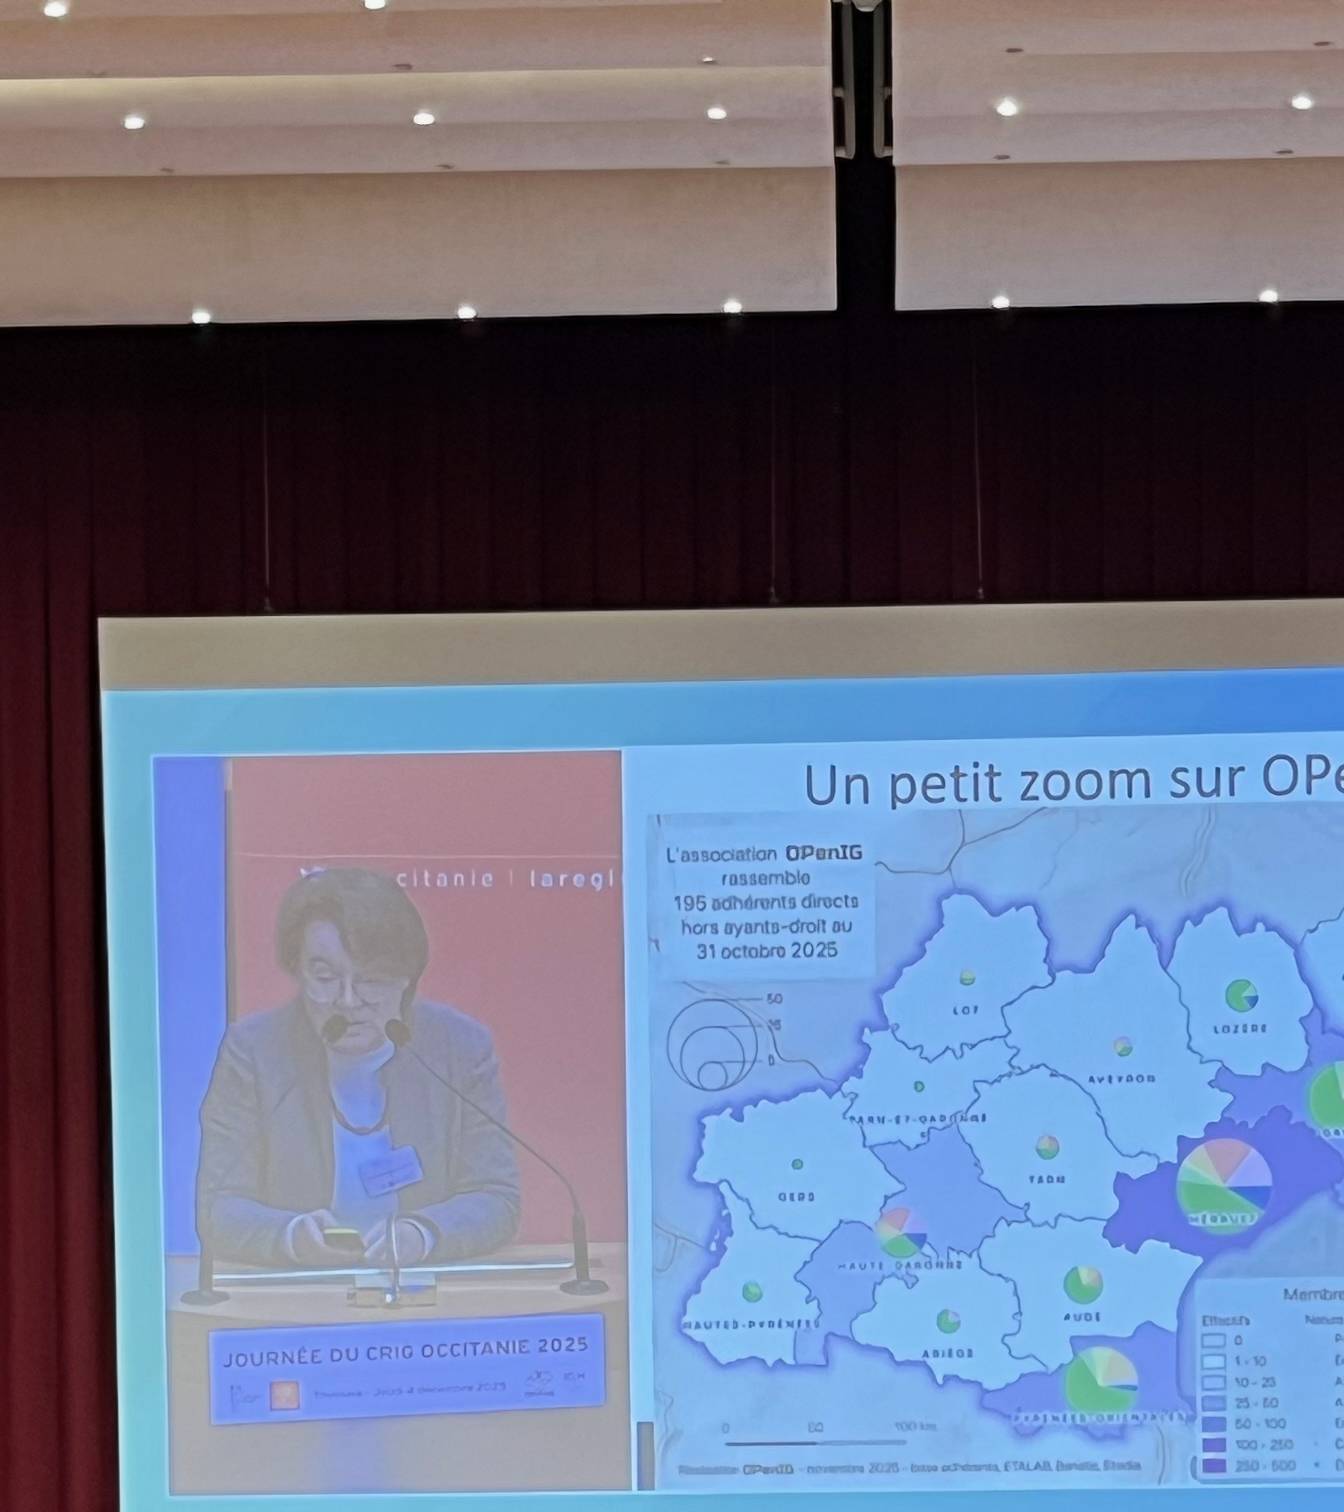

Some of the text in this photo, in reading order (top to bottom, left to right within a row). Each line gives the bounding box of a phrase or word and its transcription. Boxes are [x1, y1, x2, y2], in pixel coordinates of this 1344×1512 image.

[806, 764, 870, 805] Un
[891, 761, 1003, 810] petit
[1020, 765, 1151, 803] zoom
[1169, 765, 1246, 798] sur
[396, 867, 614, 892] citanie laregi
[791, 941, 838, 959] 2025
[223, 1345, 323, 1368] JOURNÉE
[330, 1347, 359, 1363] DU
[421, 1339, 531, 1359] OCCITANIE
[538, 1336, 589, 1354] 2025
